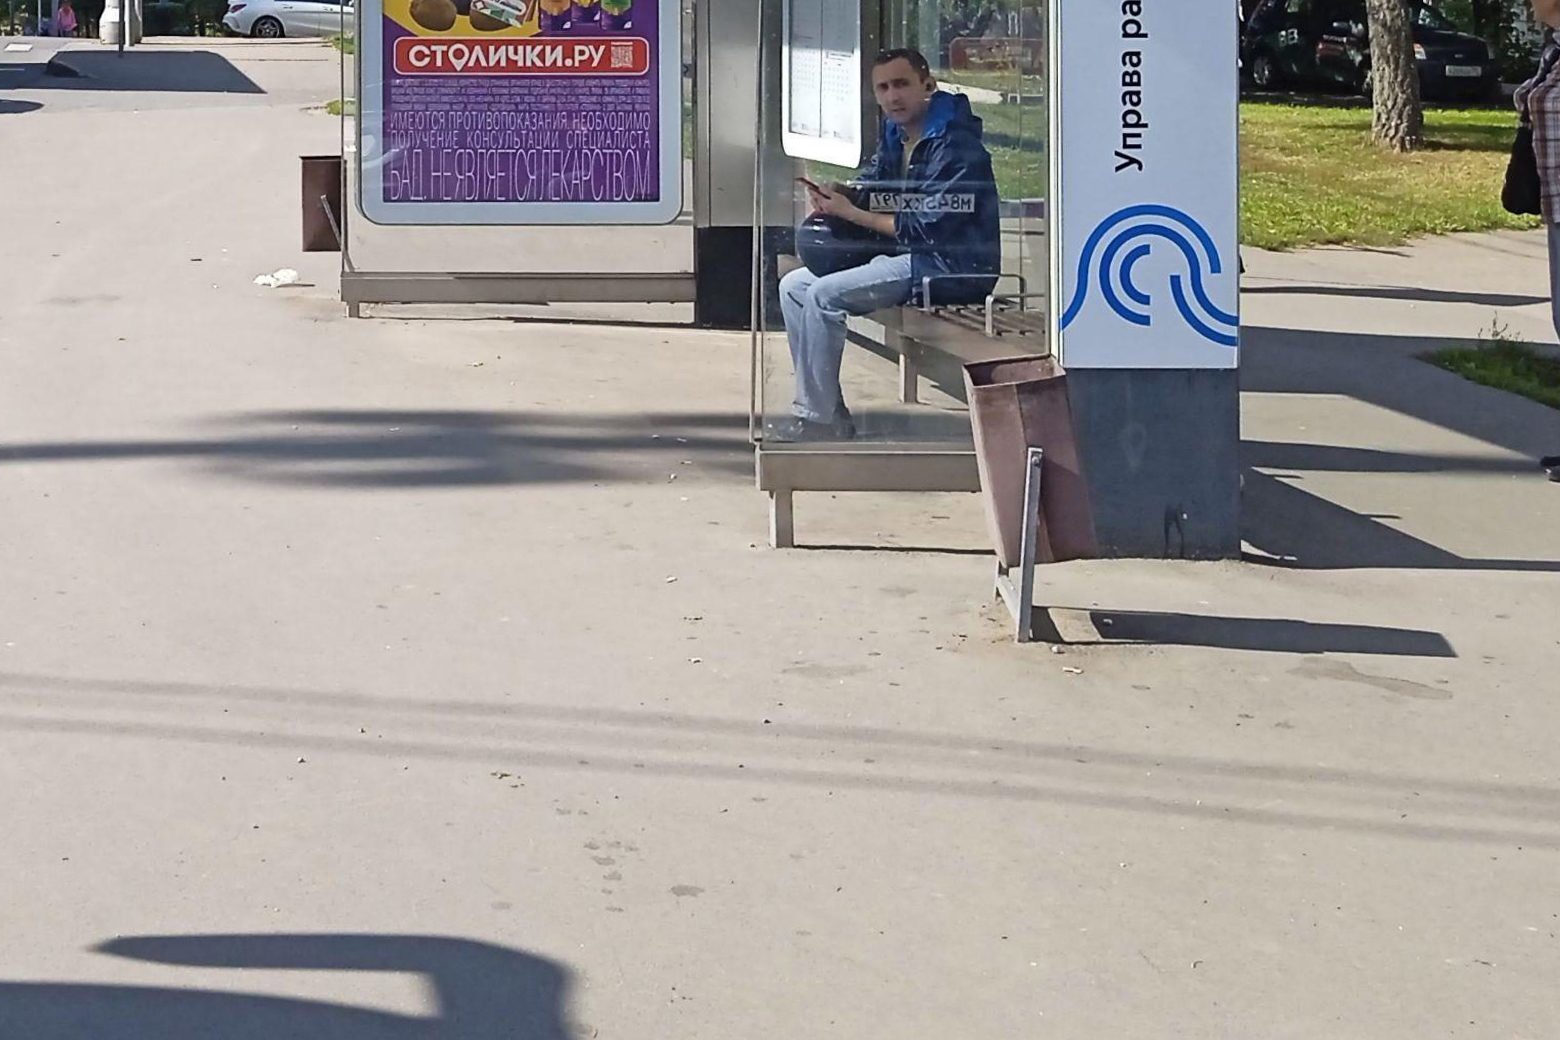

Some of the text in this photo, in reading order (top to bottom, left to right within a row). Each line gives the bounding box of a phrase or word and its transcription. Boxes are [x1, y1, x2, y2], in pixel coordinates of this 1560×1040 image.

[409, 44, 605, 71] СТОЛИЧКИ.РУ
[391, 112, 445, 130] ИМЕЮТСЯ
[572, 112, 651, 130] НЕОБХОДИМО
[1113, 51, 1148, 173] Управа
[391, 131, 651, 149] ПОЛУЧЕНИЕ КОНСУЛЬТАЦИИ СПЕЦИАЛИСТА
[430, 149, 452, 200] НЕ
[454, 149, 537, 200] ЯВЛЯЕТСЯ
[539, 149, 650, 200] ЛЕКАРСТВОМ
